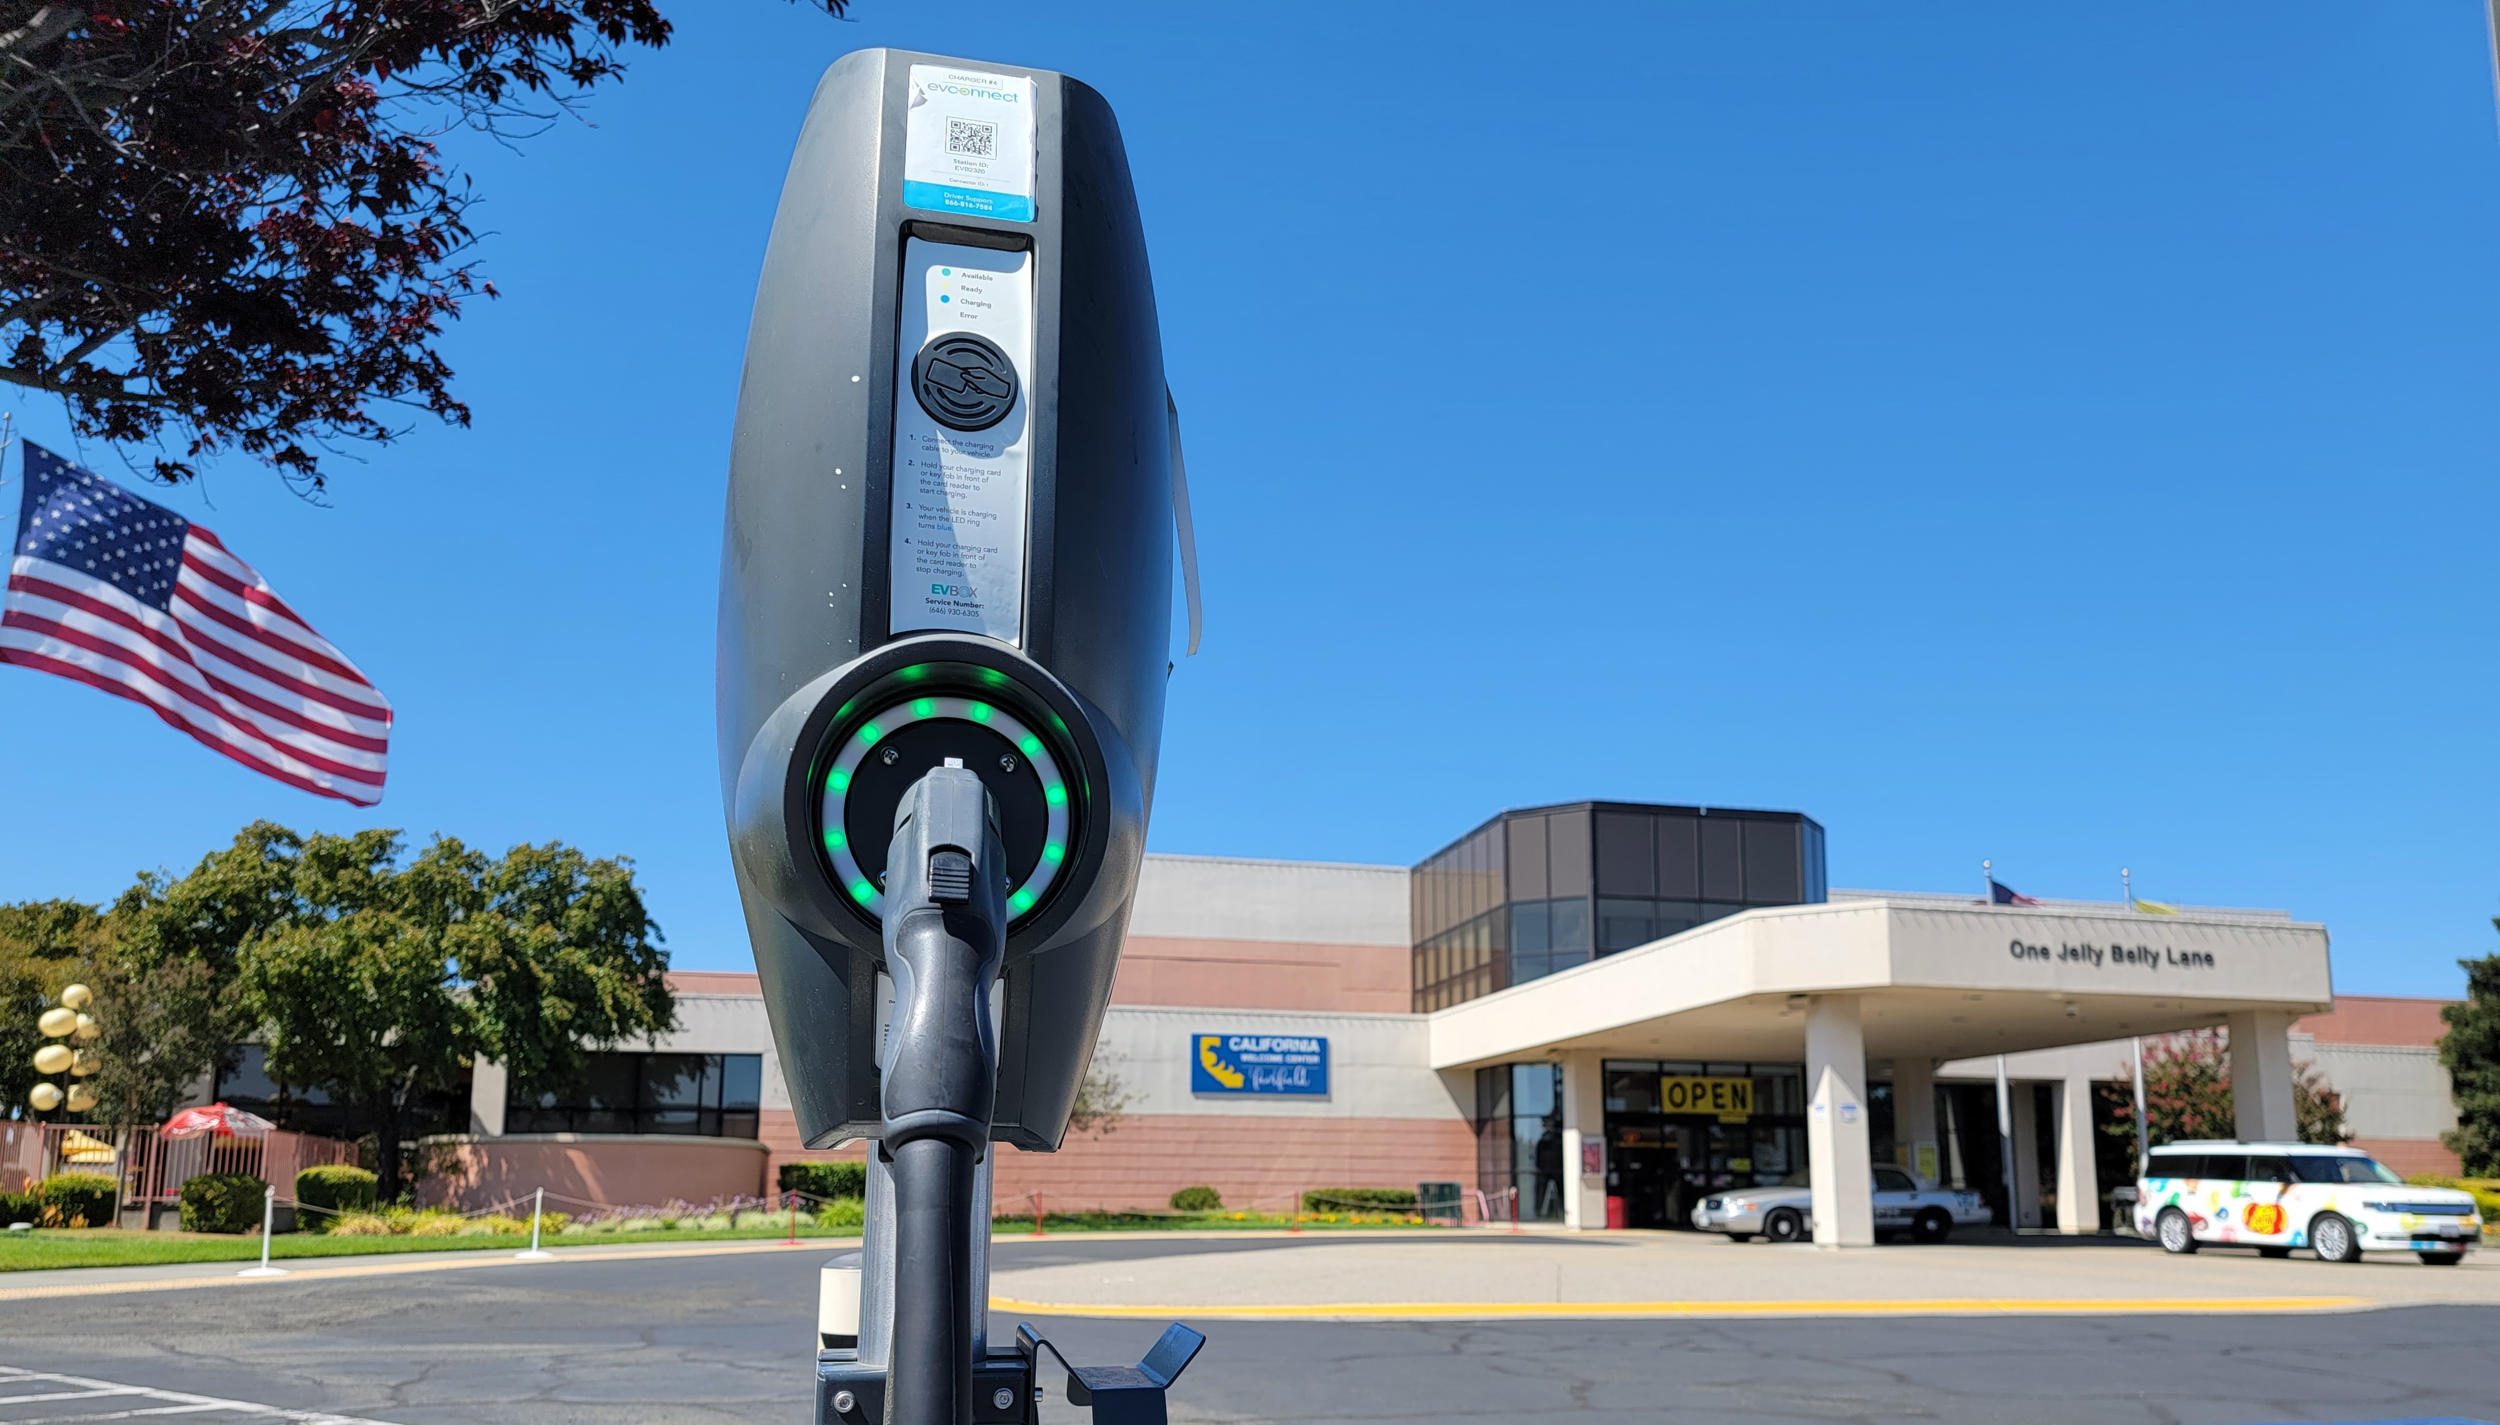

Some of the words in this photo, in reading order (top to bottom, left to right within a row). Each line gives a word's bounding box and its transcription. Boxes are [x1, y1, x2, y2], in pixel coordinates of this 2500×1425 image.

[948, 74, 987, 84] CHARGER
[953, 158, 978, 166] Station
[949, 178, 976, 186] Connector
[944, 192, 964, 200] Driver
[961, 272, 994, 282] Available
[960, 285, 983, 294] Ready
[960, 298, 992, 309] Charging
[960, 312, 978, 320] Error
[922, 436, 951, 445] Connect
[965, 441, 994, 451] charging
[967, 450, 992, 458] vehicle.
[920, 461, 938, 469] Hold
[956, 466, 984, 476] charging
[986, 468, 1001, 476] card
[930, 470, 942, 479] key
[936, 489, 968, 499] charging.
[919, 504, 934, 512] Your
[936, 506, 960, 515] vehicle
[968, 510, 997, 520] charging
[918, 513, 936, 521] when
[967, 518, 980, 527] ring
[936, 524, 954, 532] blue.
[918, 539, 934, 547] Hold
[952, 544, 982, 553] charging
[926, 548, 938, 557] key
[960, 552, 977, 560] front
[946, 560, 968, 568] reader
[916, 566, 932, 574] stop
[932, 568, 964, 578] charging.
[931, 584, 978, 598] EVBOX
[925, 598, 952, 606] Service
[953, 600, 984, 609] Number:
[929, 606, 946, 615] (646)
[948, 608, 980, 618] 930-6305
[2009, 938, 2051, 961] One
[2057, 941, 2104, 968] Jelly
[2111, 944, 2160, 970] Belly
[2166, 945, 2215, 967] Lane
[1228, 1036, 1321, 1053] CALIFORNIA
[1668, 1082, 1748, 1110] OPEN
